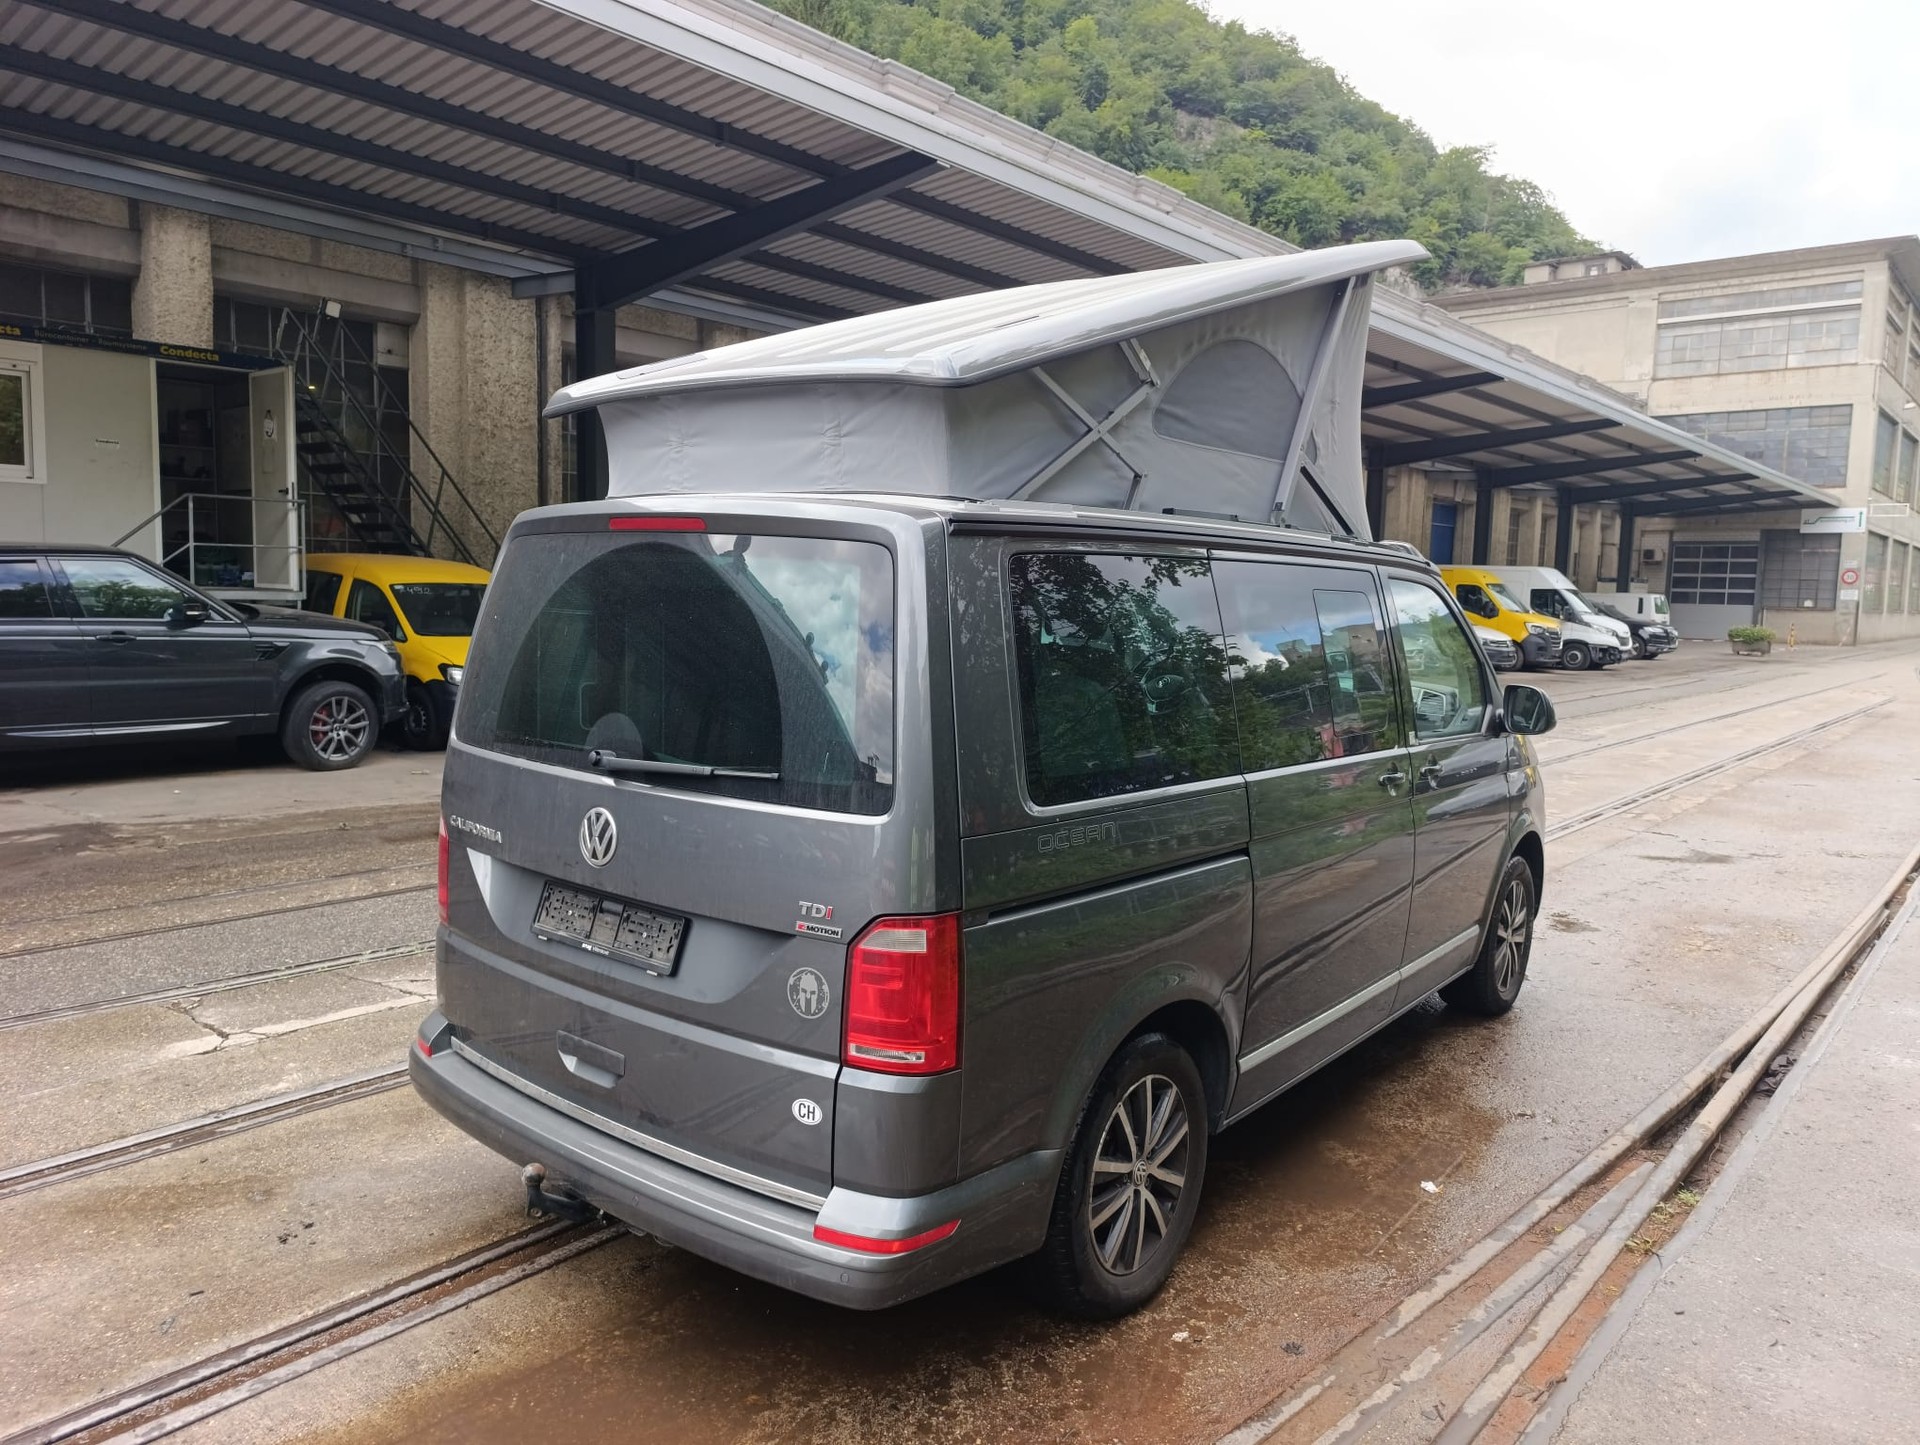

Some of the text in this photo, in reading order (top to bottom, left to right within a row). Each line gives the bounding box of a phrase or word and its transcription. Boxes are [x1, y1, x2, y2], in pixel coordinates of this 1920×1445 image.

[160, 346, 219, 361] Condecta
[450, 815, 502, 844] CALIFORNIA
[1038, 821, 1116, 853] OCEAN
[799, 901, 833, 920] TDI
[798, 1102, 816, 1122] CH
